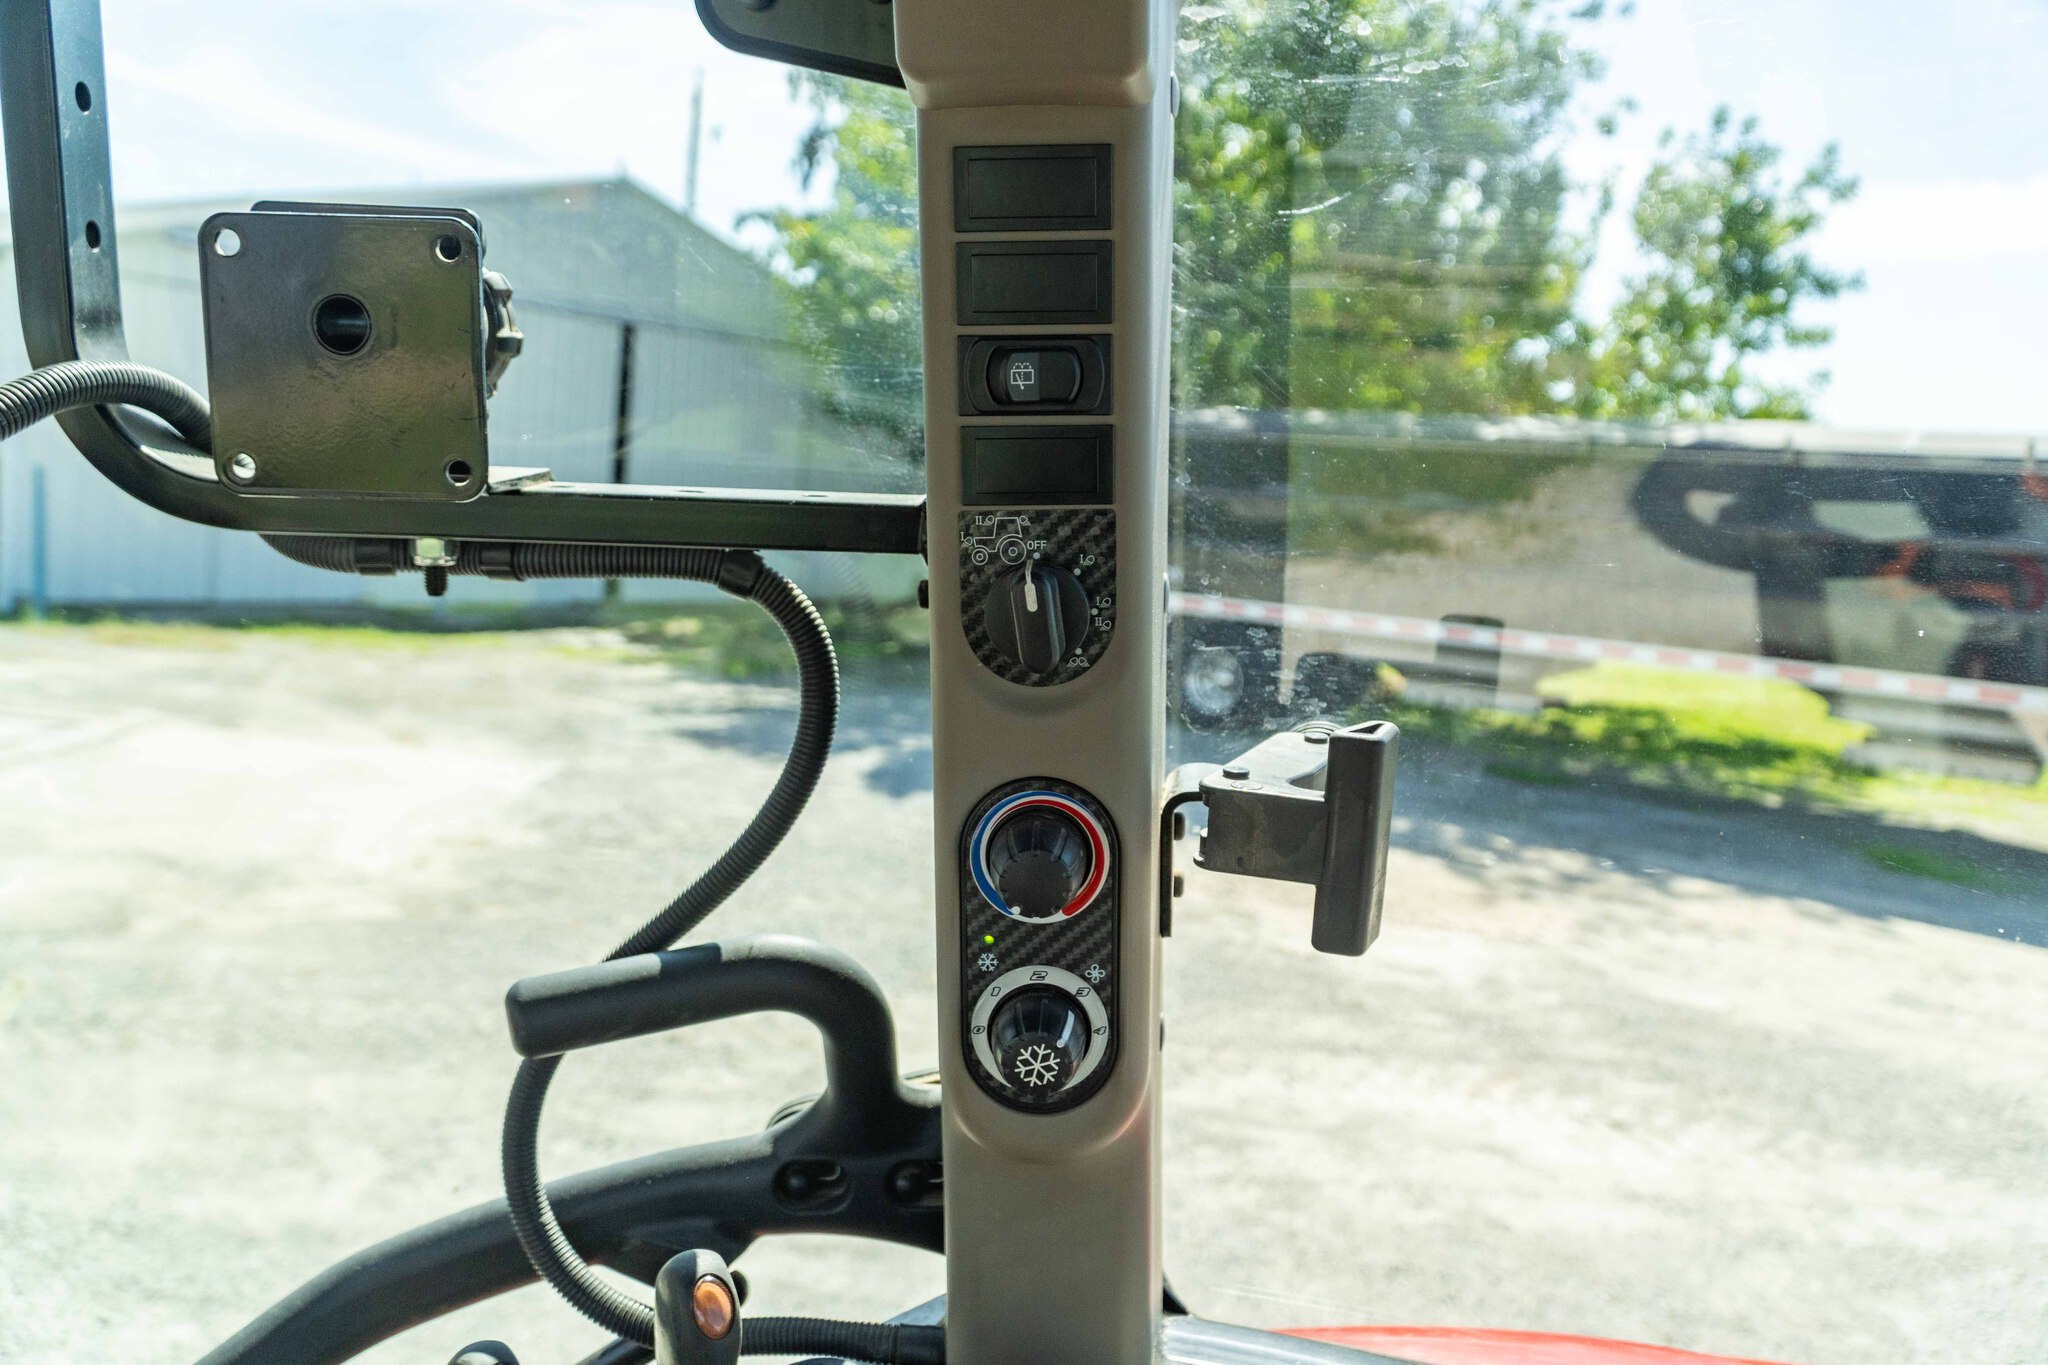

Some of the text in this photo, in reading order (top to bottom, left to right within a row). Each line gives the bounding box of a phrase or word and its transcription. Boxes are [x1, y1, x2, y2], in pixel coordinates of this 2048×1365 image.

[1027, 540, 1047, 550] OFF
[1029, 970, 1049, 981] 2
[991, 986, 1002, 997] 1
[1075, 986, 1092, 997] 3
[972, 1025, 986, 1035] 0
[1093, 1026, 1107, 1035] 4
